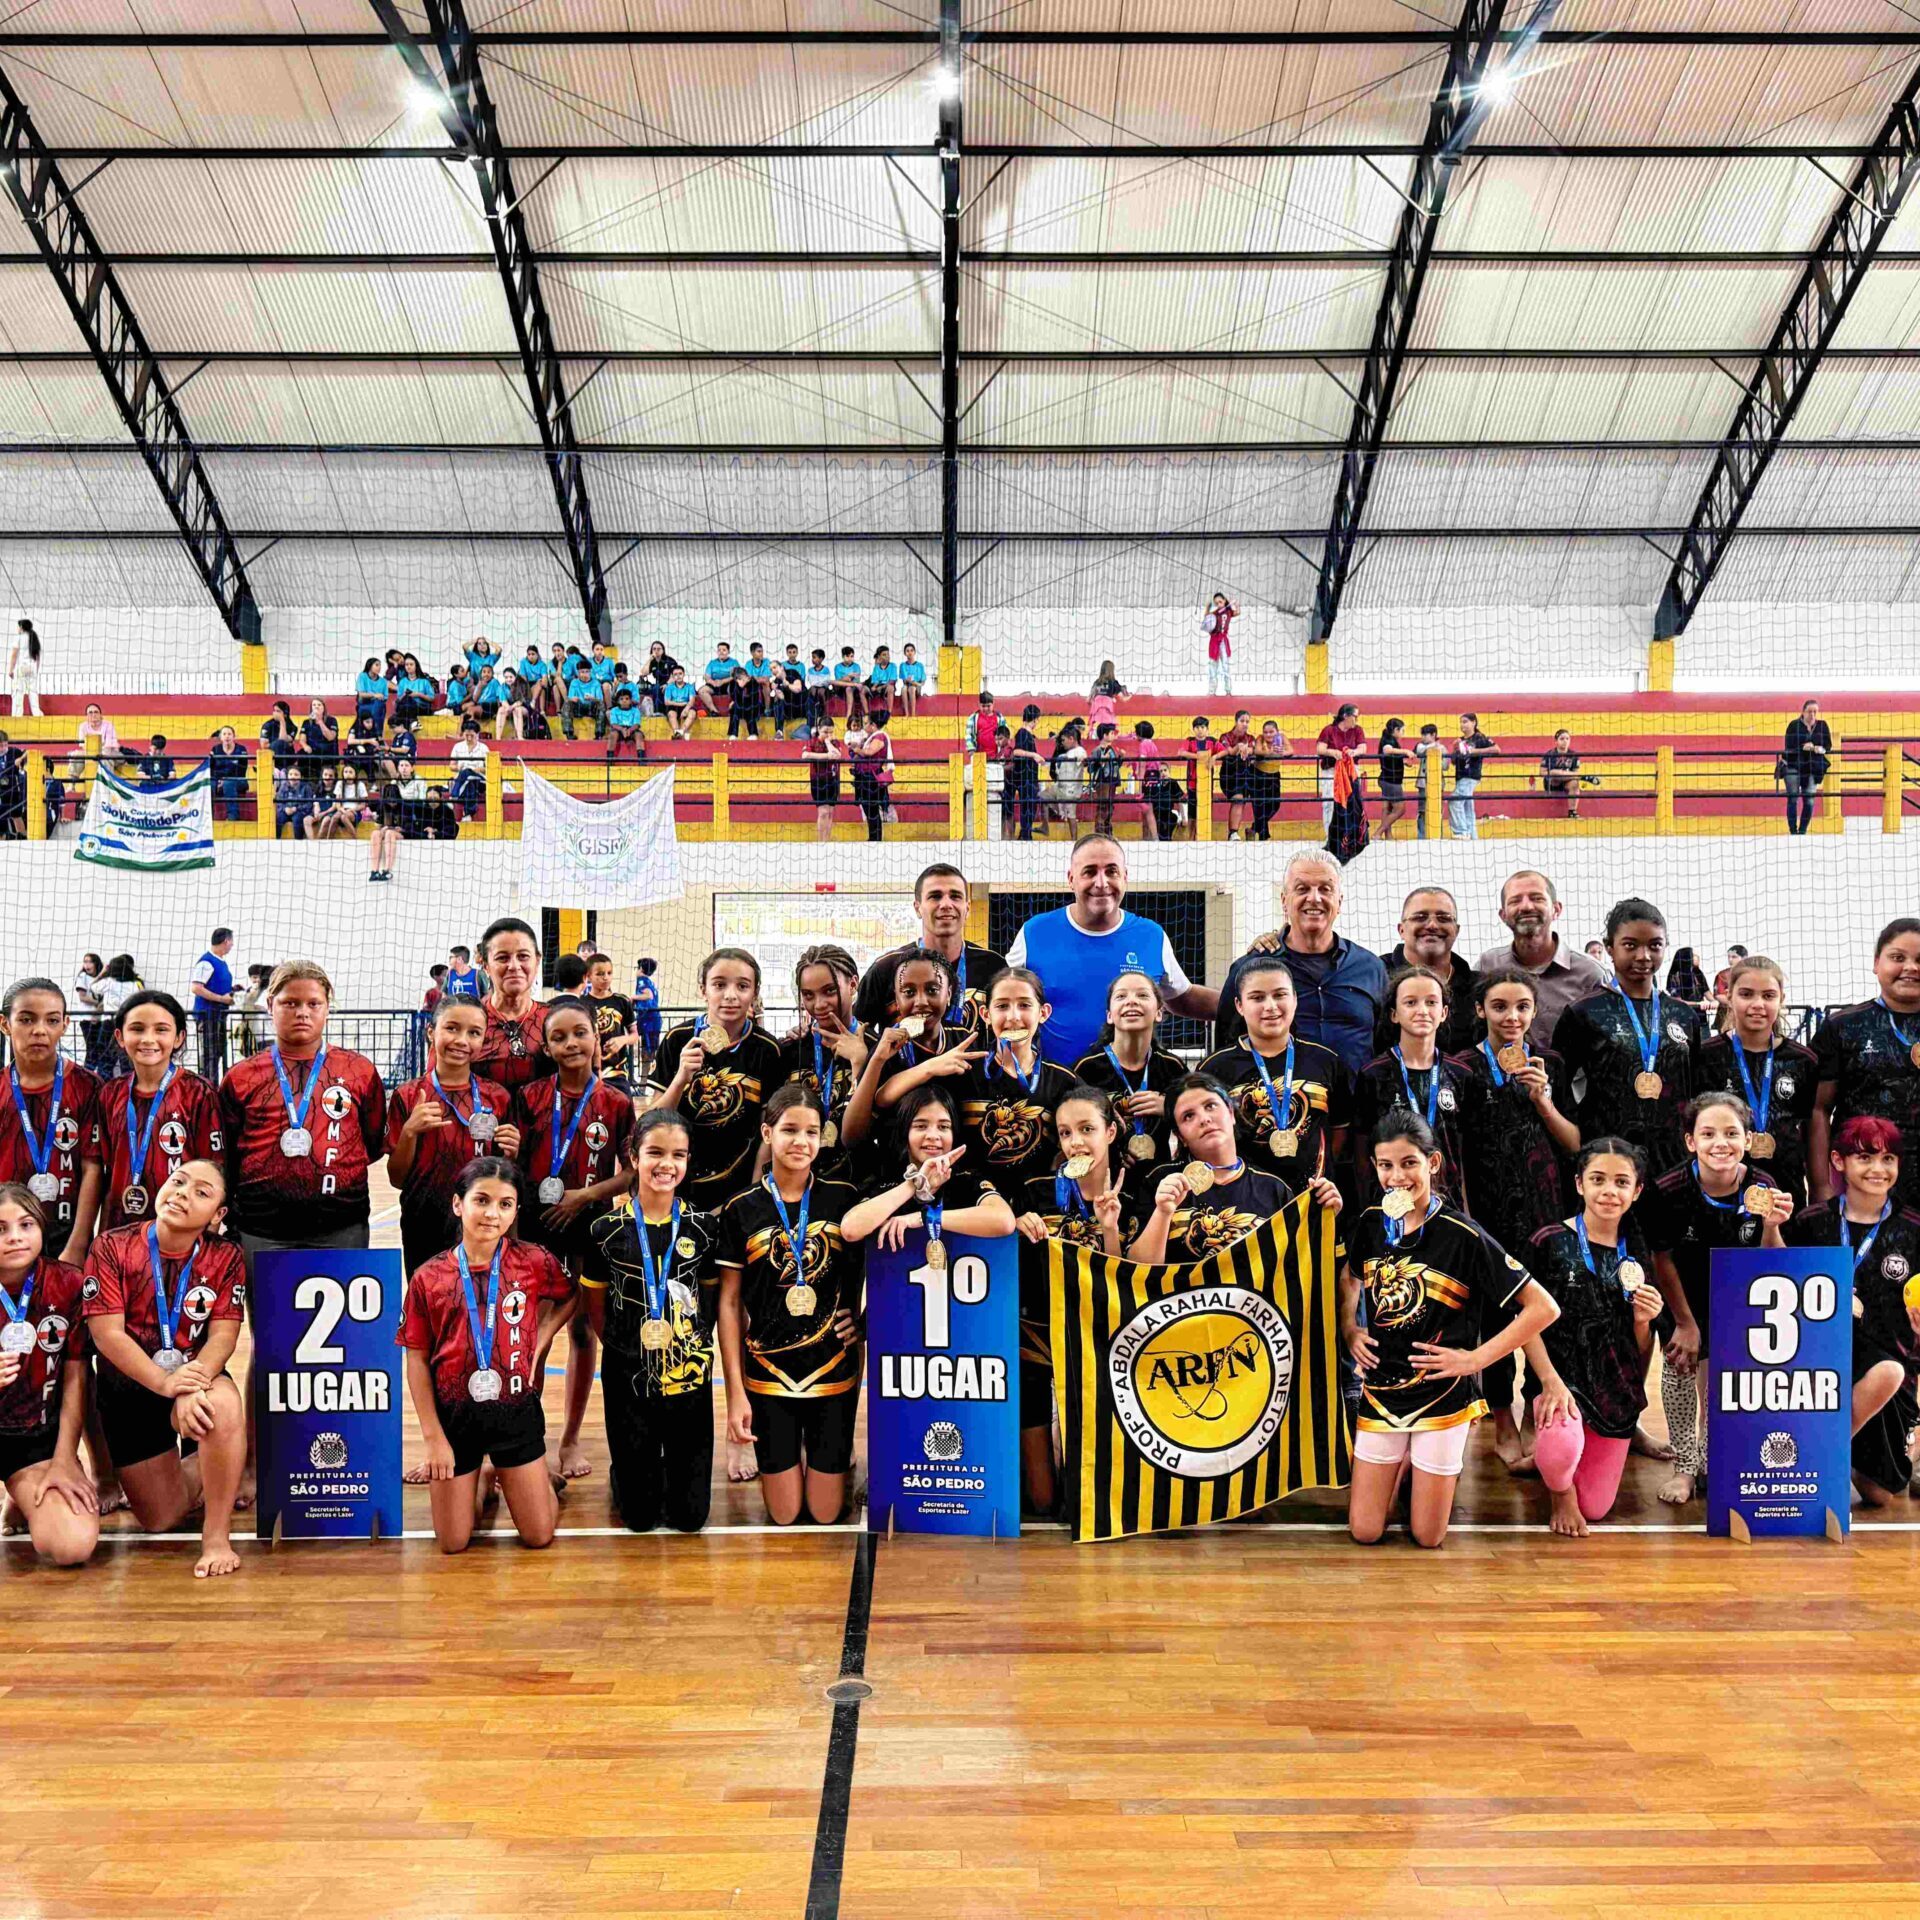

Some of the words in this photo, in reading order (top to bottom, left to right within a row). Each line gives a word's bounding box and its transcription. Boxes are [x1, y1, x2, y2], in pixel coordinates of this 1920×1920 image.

[578, 837, 623, 855] GISF
[1160, 1292, 1236, 1319] RAHAL
[1240, 1296, 1291, 1363] FARHAT
[881, 1355, 1006, 1400] LUGAR
[268, 1371, 390, 1412] LUGAR
[1721, 1371, 1838, 1411] LUGAR
[289, 1472, 353, 1480] PREFEITURA
[902, 1463, 968, 1472] PREFEITURA
[971, 1465, 985, 1473] DE
[290, 1482, 319, 1495] SÃO
[322, 1484, 369, 1495] PEDRO
[902, 1474, 932, 1488] SÃO
[935, 1477, 985, 1490] PEDRO
[1740, 1482, 1768, 1495] SÃO
[1771, 1483, 1818, 1494] PEDRO
